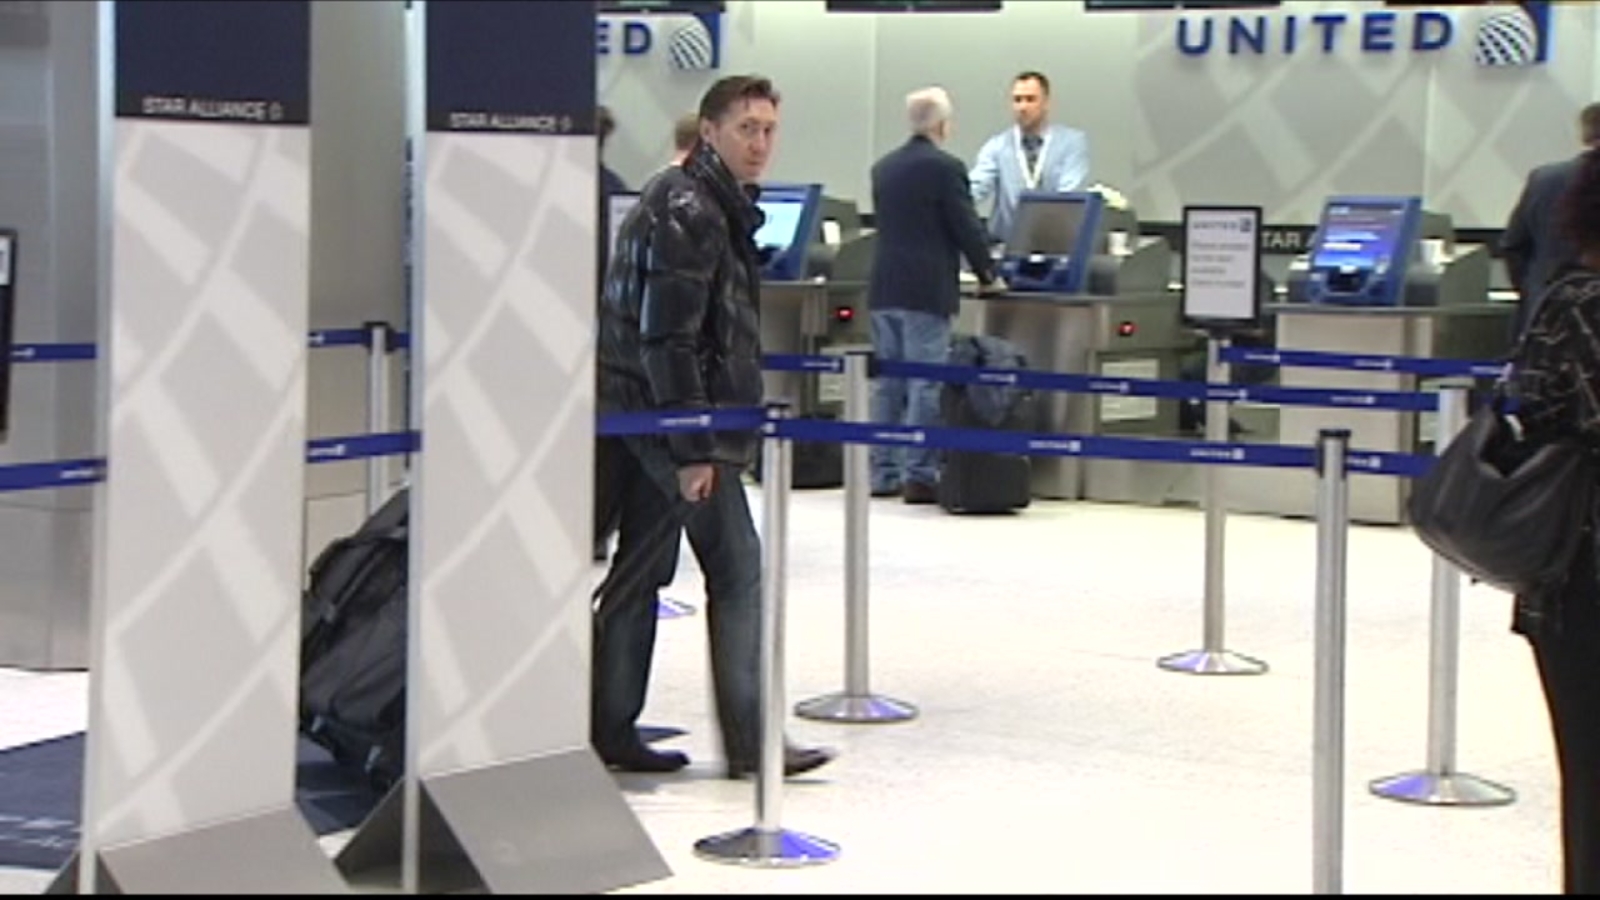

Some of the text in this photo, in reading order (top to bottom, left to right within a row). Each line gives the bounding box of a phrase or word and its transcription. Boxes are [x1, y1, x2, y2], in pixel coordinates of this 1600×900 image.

[1176, 12, 1454, 54] UNITED
[141, 96, 267, 121] STAR ALLIANCE
[450, 112, 557, 132] STAR ALLIANCE
